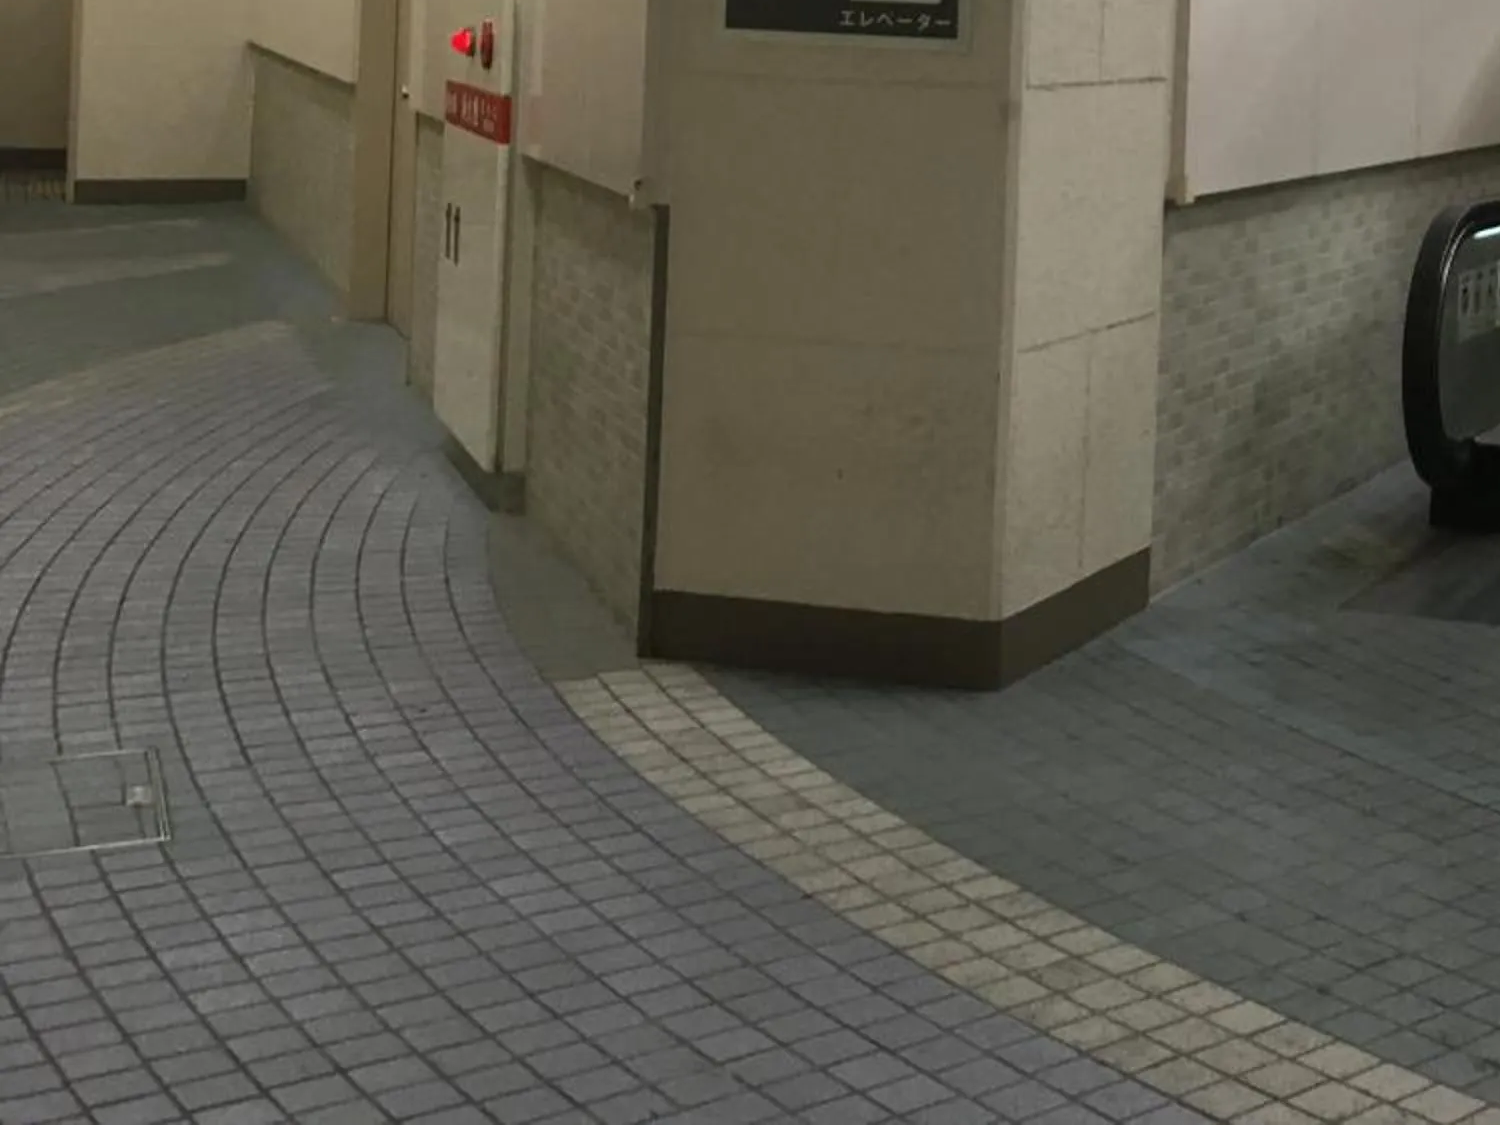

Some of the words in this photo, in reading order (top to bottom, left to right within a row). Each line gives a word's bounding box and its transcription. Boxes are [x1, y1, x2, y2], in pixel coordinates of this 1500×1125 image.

[839, 10, 951, 32] エレベーター
